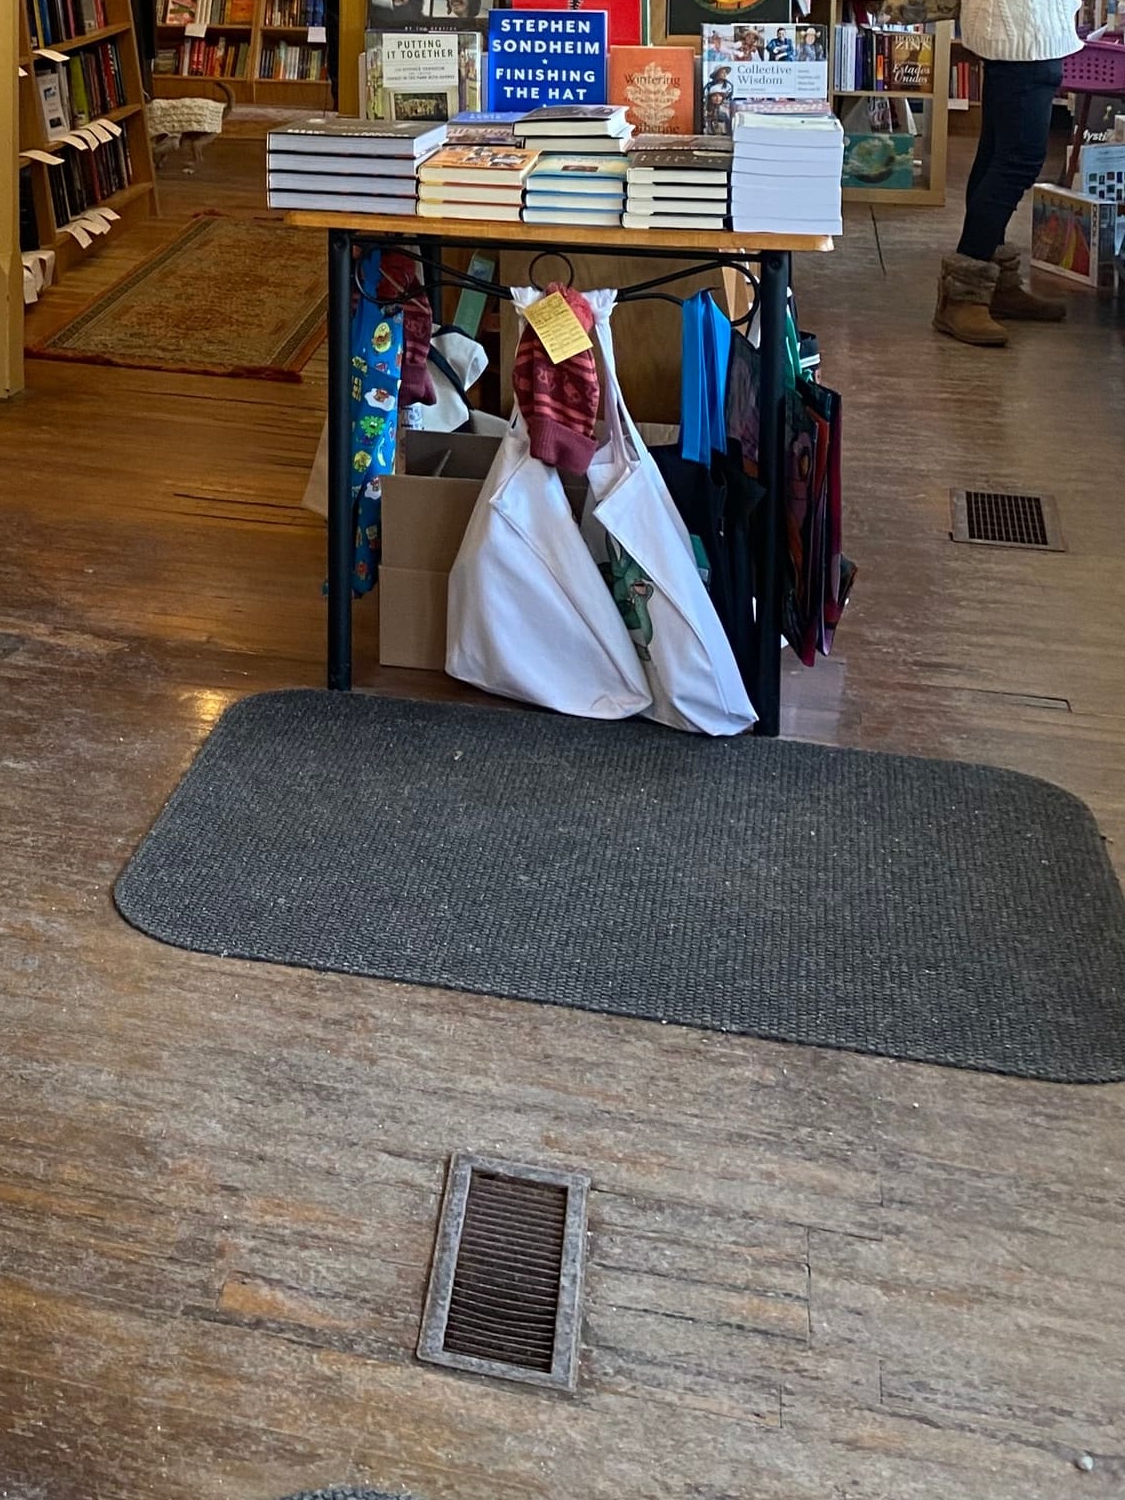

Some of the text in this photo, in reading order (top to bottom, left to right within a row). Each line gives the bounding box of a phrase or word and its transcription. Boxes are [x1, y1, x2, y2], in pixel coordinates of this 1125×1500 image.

[499, 18, 592, 34] STEPHEN
[397, 39, 442, 50] PUTTING
[491, 38, 601, 56] SONDHEIM
[895, 41, 933, 51] ZINN
[387, 49, 454, 60] IT TOGETHER
[494, 67, 596, 84] FINISHING
[736, 64, 793, 75] Collective
[892, 62, 931, 76] Estados
[624, 73, 681, 87] Wintering
[737, 75, 784, 86] Wisdom
[893, 72, 929, 85] Unidos
[503, 86, 588, 102] THE HAT
